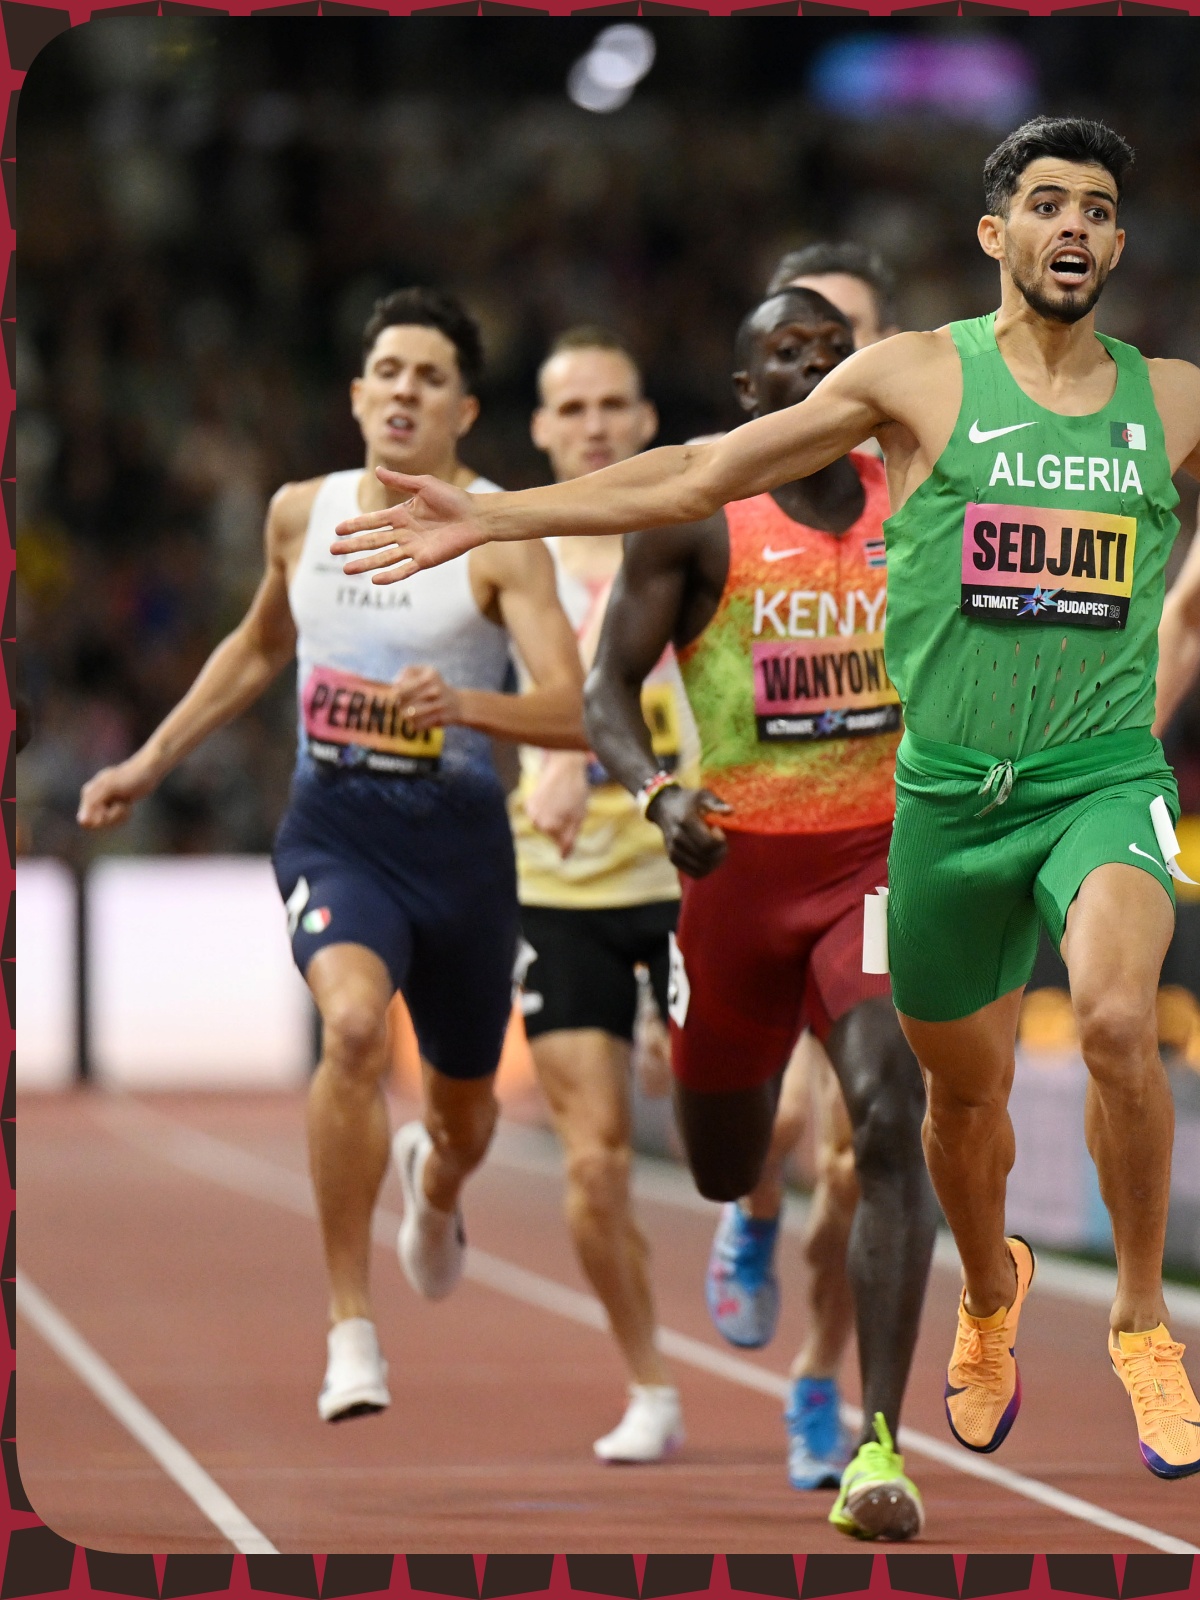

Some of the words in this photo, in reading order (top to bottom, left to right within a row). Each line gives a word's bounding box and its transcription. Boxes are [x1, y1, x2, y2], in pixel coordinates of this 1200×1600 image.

[988, 451, 1144, 496] ALGERIA
[972, 520, 1128, 583] SEDJATI
[335, 584, 414, 611] ITALIA
[753, 587, 887, 638] KENY
[972, 593, 1019, 610] ULTIMATE
[1056, 599, 1110, 618] BUDAPEST
